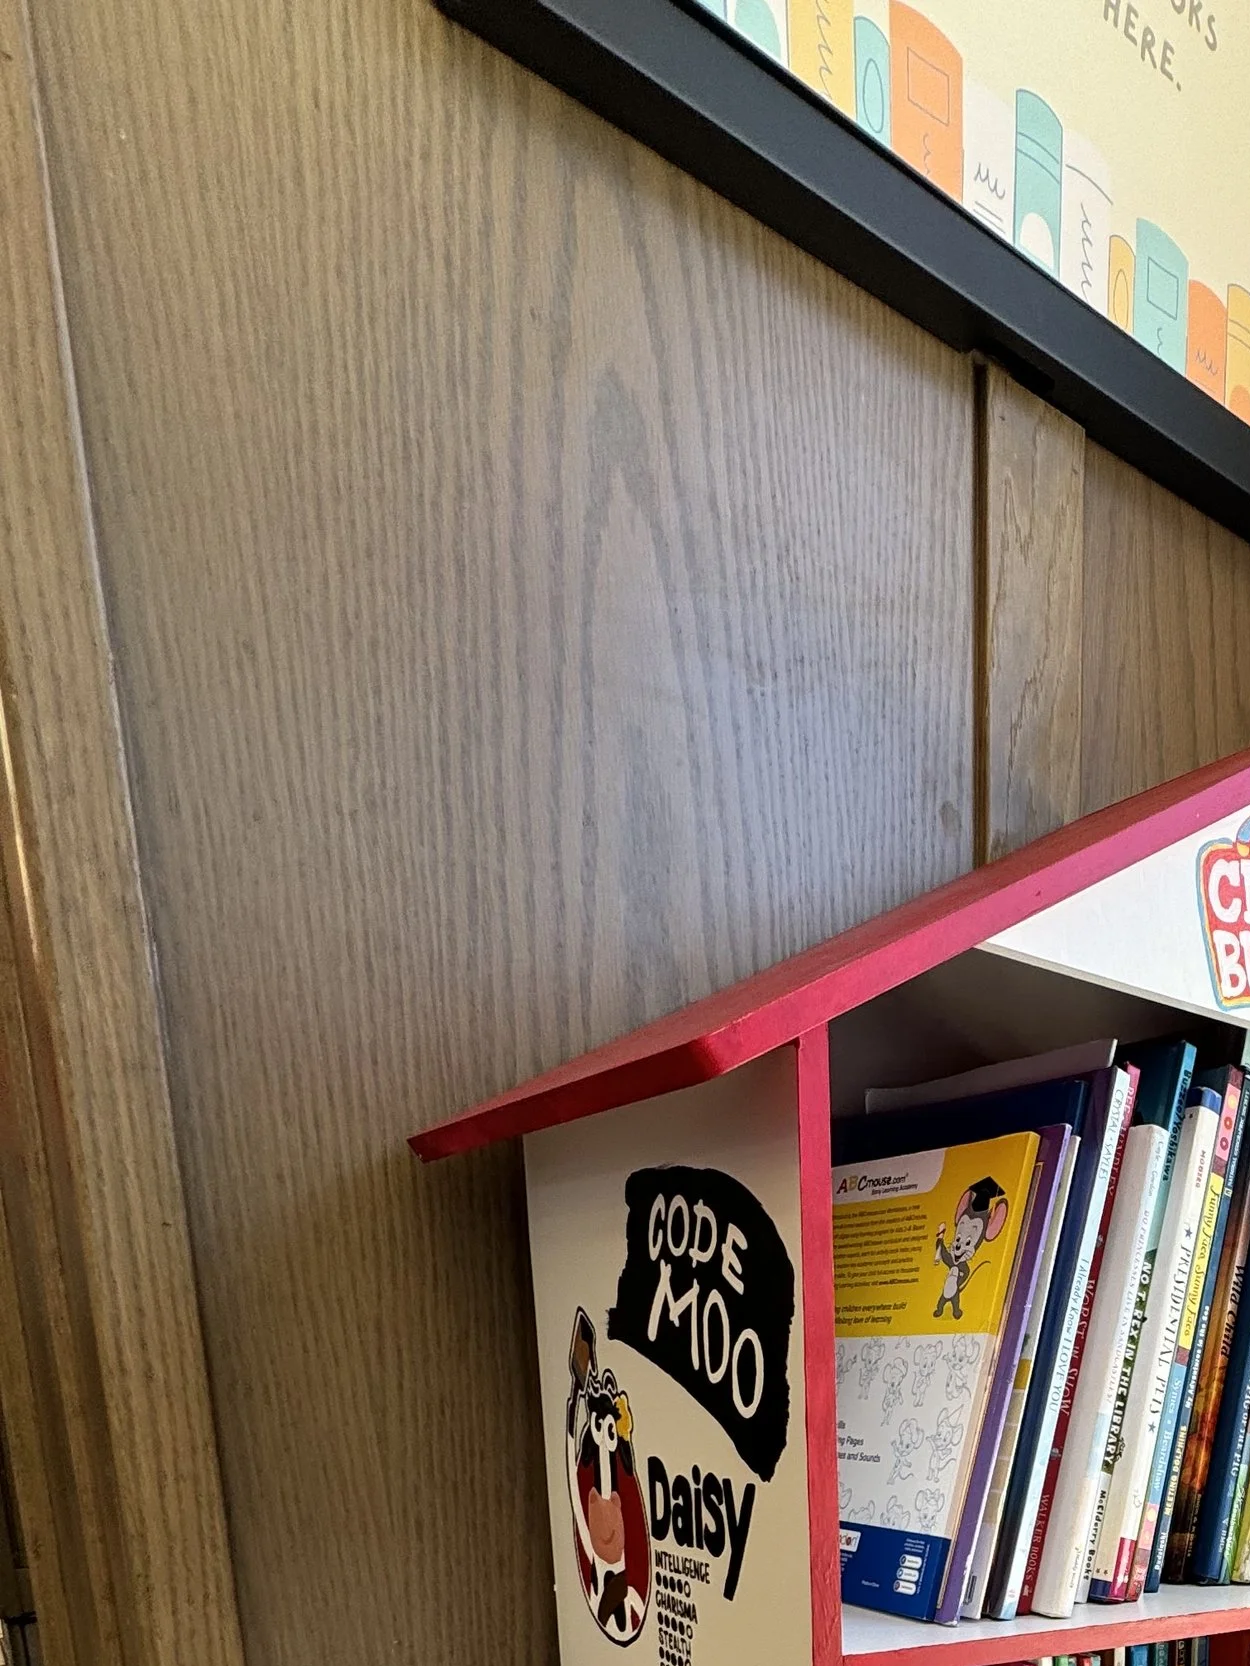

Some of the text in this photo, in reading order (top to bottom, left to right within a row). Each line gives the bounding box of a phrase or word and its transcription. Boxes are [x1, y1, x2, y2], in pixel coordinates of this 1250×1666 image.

[1103, 0, 1181, 91] HERE.
[1098, 1088, 1122, 1180] CRYSTAL SAYLES
[1233, 1120, 1244, 1156] GEOGRAPHIC
[649, 1194, 747, 1295] CODE
[1202, 1186, 1216, 1228] Funny
[1189, 1264, 1203, 1305] Sunny
[1219, 1264, 1244, 1357] Wild Child
[648, 1261, 765, 1418] MOO
[1049, 1264, 1086, 1413] Already Know LOVE YOU
[1117, 1261, 1151, 1397] NO REX IN THE
[1149, 1246, 1190, 1415] PRESIDENTIAL PETS
[1187, 1350, 1200, 1394] Adventures
[1198, 1323, 1206, 1338] the
[1058, 1366, 1077, 1417] SHOW
[845, 1436, 863, 1447] Pages
[859, 1452, 880, 1463] Sounds
[1153, 1378, 1180, 1490] Symes Beardshaw
[1164, 1425, 1186, 1515] MEETING DOLPHINS
[1230, 1452, 1240, 1476] PIG
[648, 1456, 755, 1601] Daisy
[655, 1549, 710, 1584] INTELLIGENCE
[1025, 1493, 1049, 1582] WALKER BOOKS
[1082, 1549, 1095, 1580] Books
[656, 1590, 697, 1624] CHARISMA
[659, 1627, 691, 1656] STEALTH
